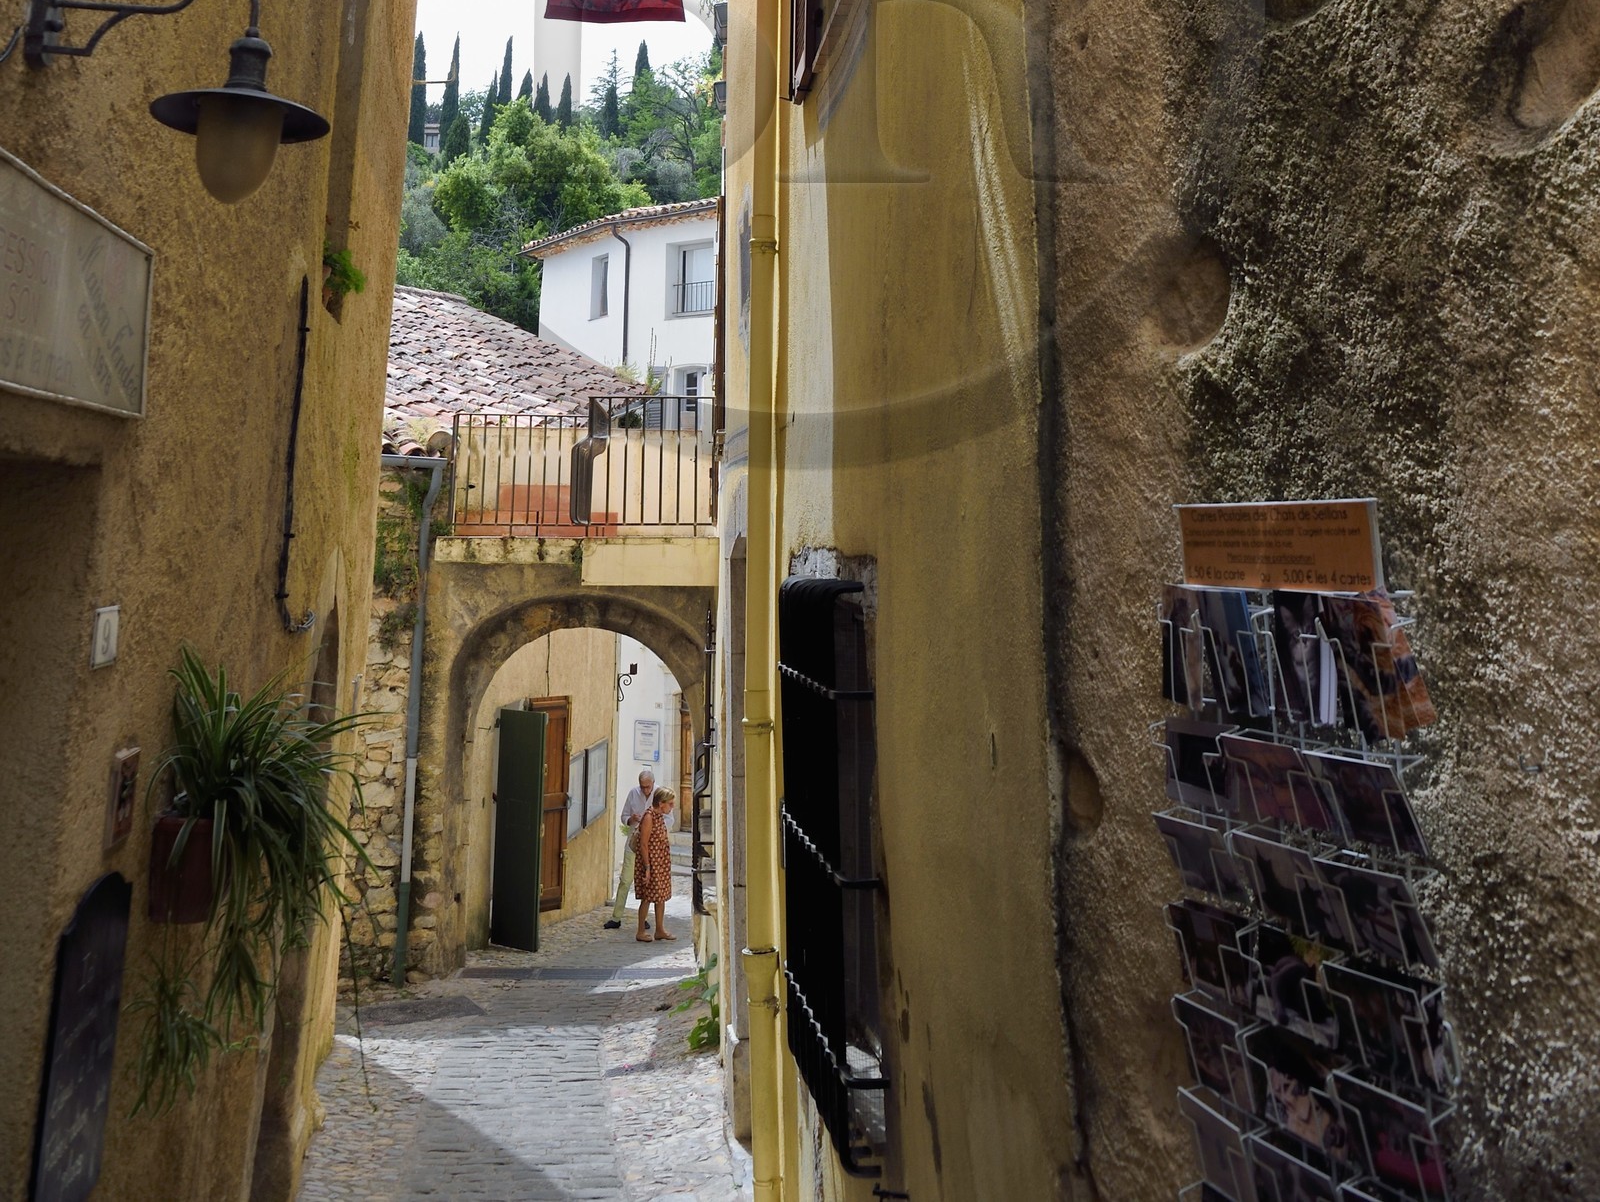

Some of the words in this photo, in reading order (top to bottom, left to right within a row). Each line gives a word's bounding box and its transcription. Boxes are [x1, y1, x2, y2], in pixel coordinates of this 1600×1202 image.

[1191, 509, 1217, 523] Cartes
[1218, 508, 1251, 522] Postales
[1270, 507, 1296, 521] Chats
[1297, 506, 1311, 520] de
[1206, 565, 1212, 579] €
[1213, 566, 1222, 580] la
[1223, 569, 1246, 581] carte
[1260, 572, 1271, 583] ou
[1306, 569, 1313, 584] €
[1314, 570, 1328, 584] les
[1330, 570, 1337, 585] 4
[1339, 572, 1372, 586] cartes
[101, 618, 111, 655] 9
